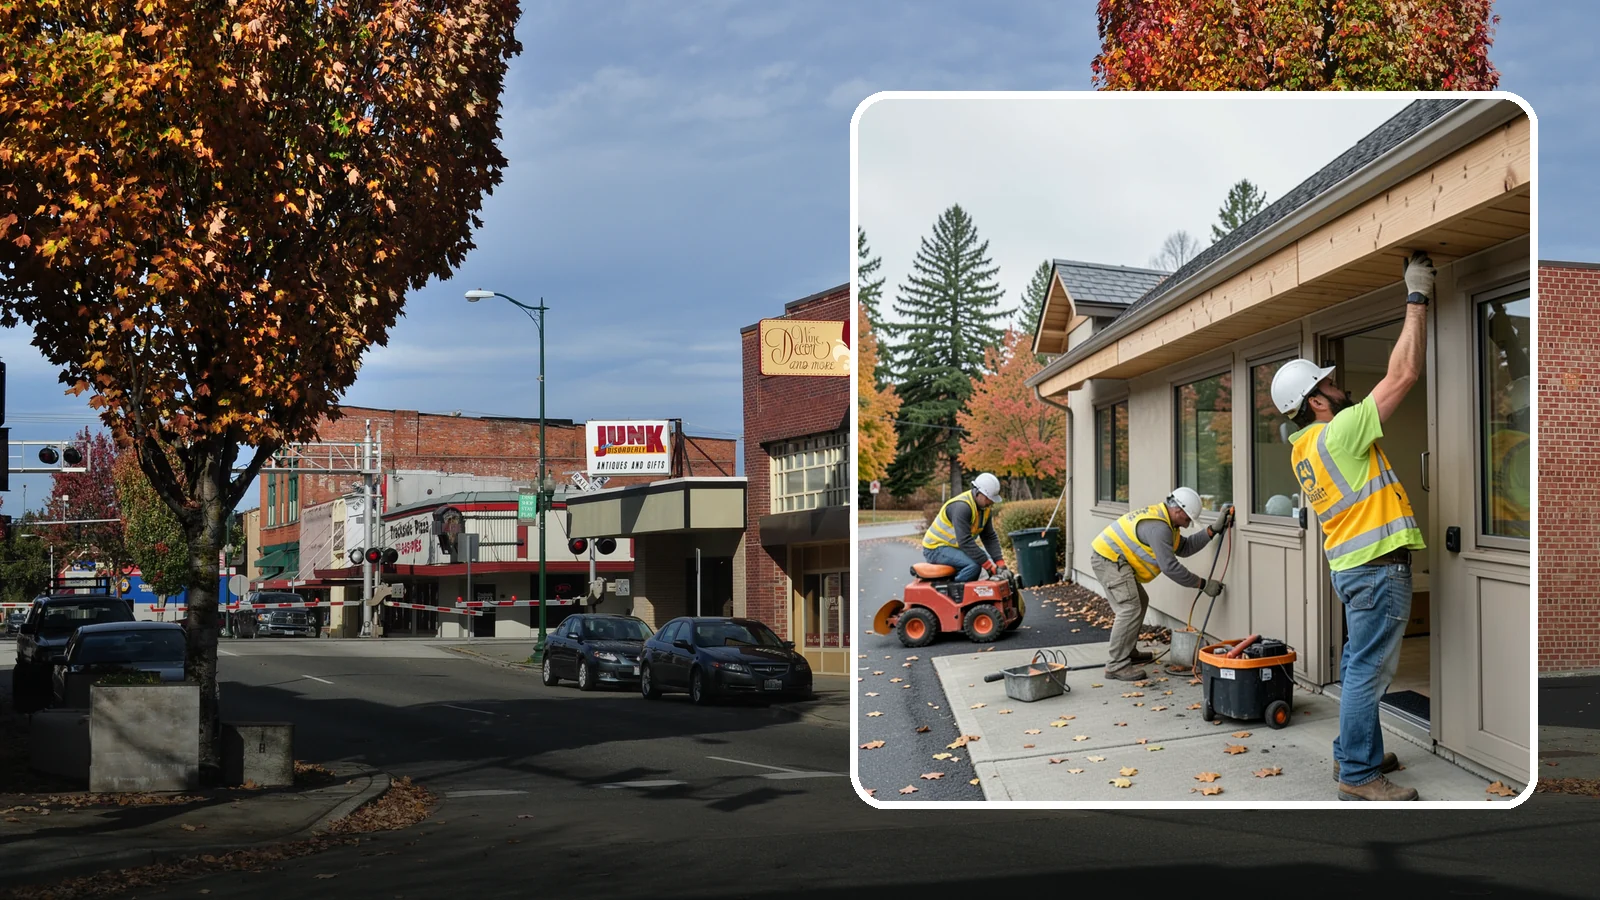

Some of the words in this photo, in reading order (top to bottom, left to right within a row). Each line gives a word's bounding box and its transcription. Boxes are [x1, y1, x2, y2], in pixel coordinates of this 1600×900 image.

[765, 327, 831, 365] Decor
[595, 425, 665, 457] JUNK
[607, 446, 646, 454] DISORDERLY
[597, 461, 628, 470] ANTIQUES
[631, 461, 644, 470] AND
[647, 460, 665, 470] GIFTS
[414, 519, 429, 535] Pizza
